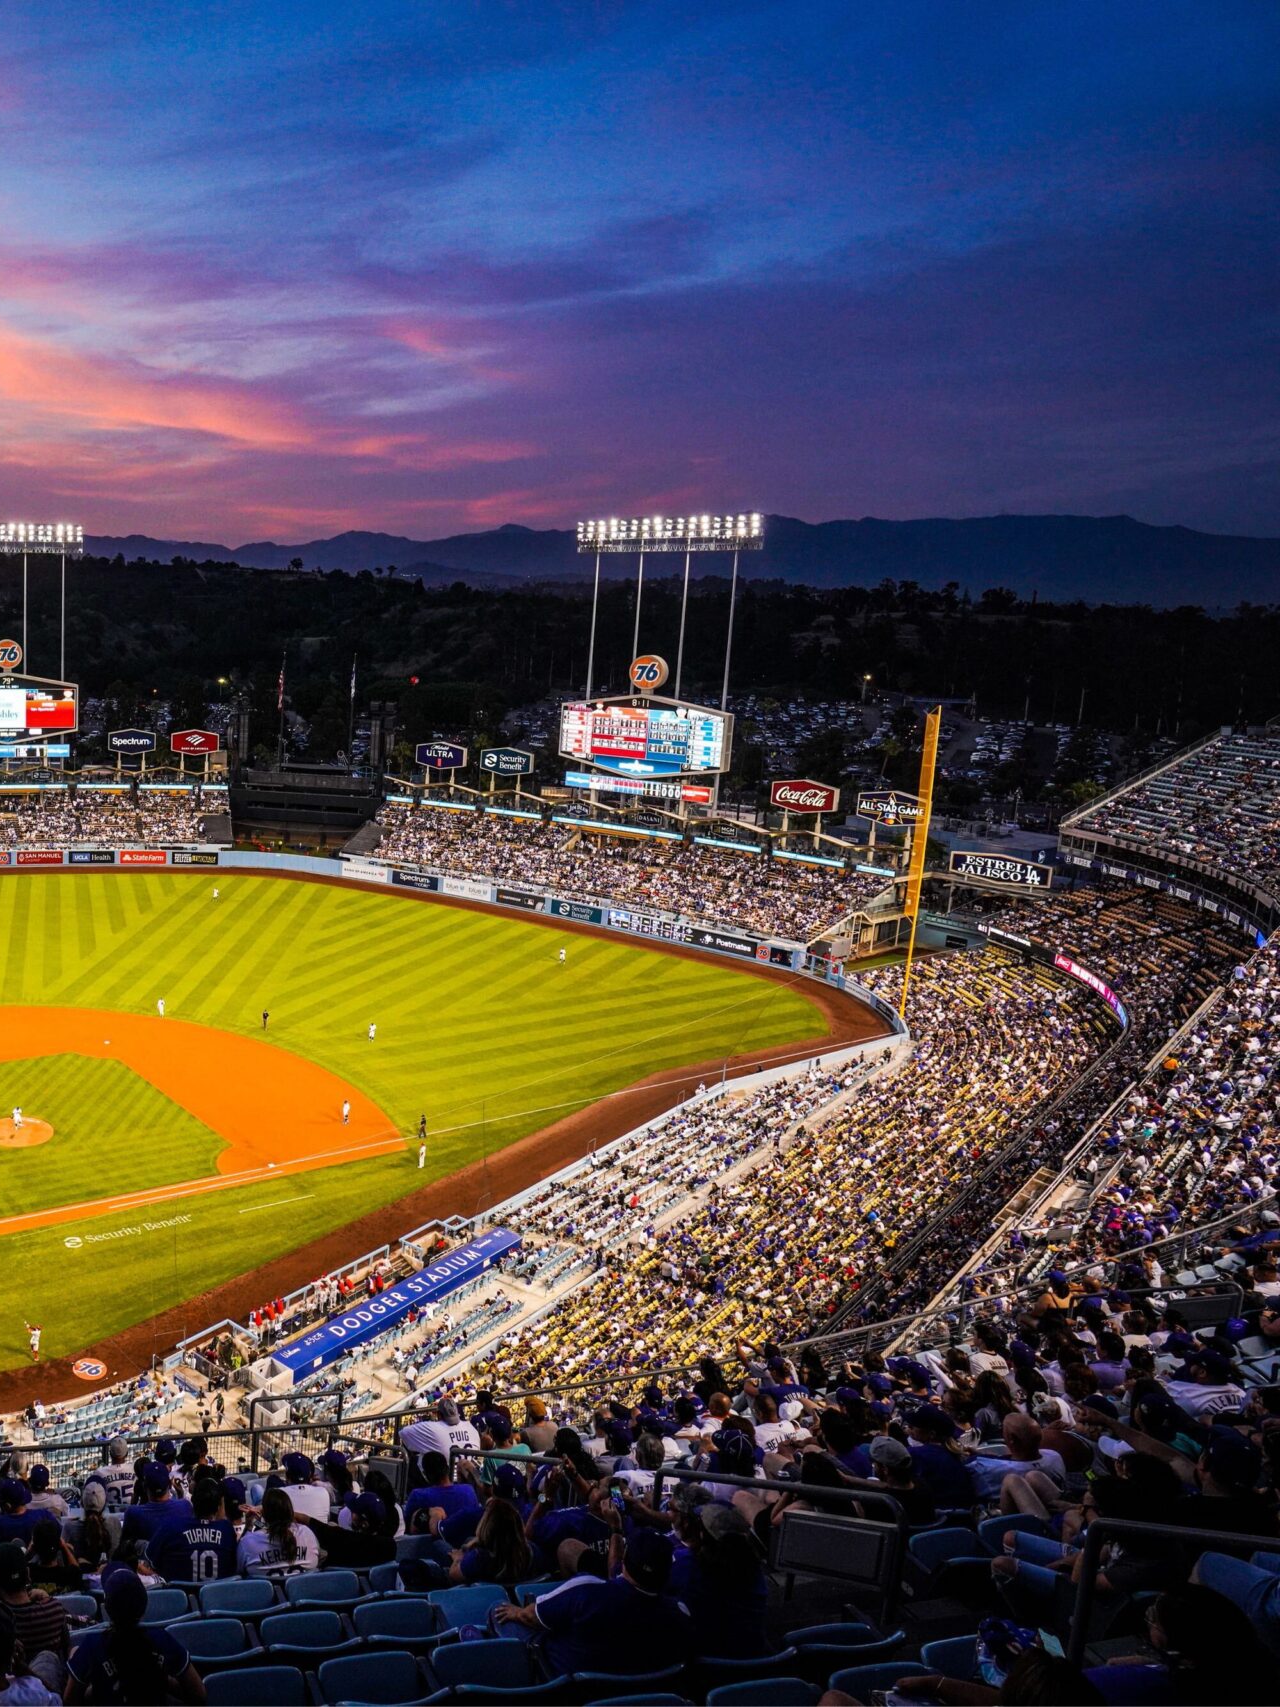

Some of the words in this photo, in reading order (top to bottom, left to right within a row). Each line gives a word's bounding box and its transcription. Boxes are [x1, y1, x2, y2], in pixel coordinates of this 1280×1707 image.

[635, 663, 660, 682] 76
[632, 699, 650, 708] 8:11
[112, 736, 152, 747] Spectrum
[426, 749, 454, 758] ULTRA
[500, 754, 526, 764] Security
[499, 762, 522, 770] Benefit
[661, 787, 667, 796] 0
[668, 788, 674, 797] 0
[675, 789, 681, 798] 0
[776, 786, 830, 808] Coca-Cola
[898, 805, 925, 816] GAME
[638, 815, 660, 824] DASANI
[399, 873, 430, 883] Spectrum
[957, 863, 1021, 882] JALISCO
[1025, 865, 1040, 885] LA
[469, 886, 481, 894] blue
[571, 905, 593, 915] Security
[571, 912, 590, 920] Benefit
[716, 938, 751, 952] Postmates
[84, 1224, 141, 1243] Security
[142, 1214, 192, 1231] Benefit
[329, 1292, 408, 1338] DODGER
[407, 1249, 482, 1292] STADIUM
[79, 1362, 102, 1376] 76
[449, 1432, 470, 1442] PUIG
[108, 1484, 134, 1504] 35
[183, 1530, 222, 1544] TURNER
[258, 1546, 307, 1565] KERSAW
[190, 1550, 218, 1582] 10
